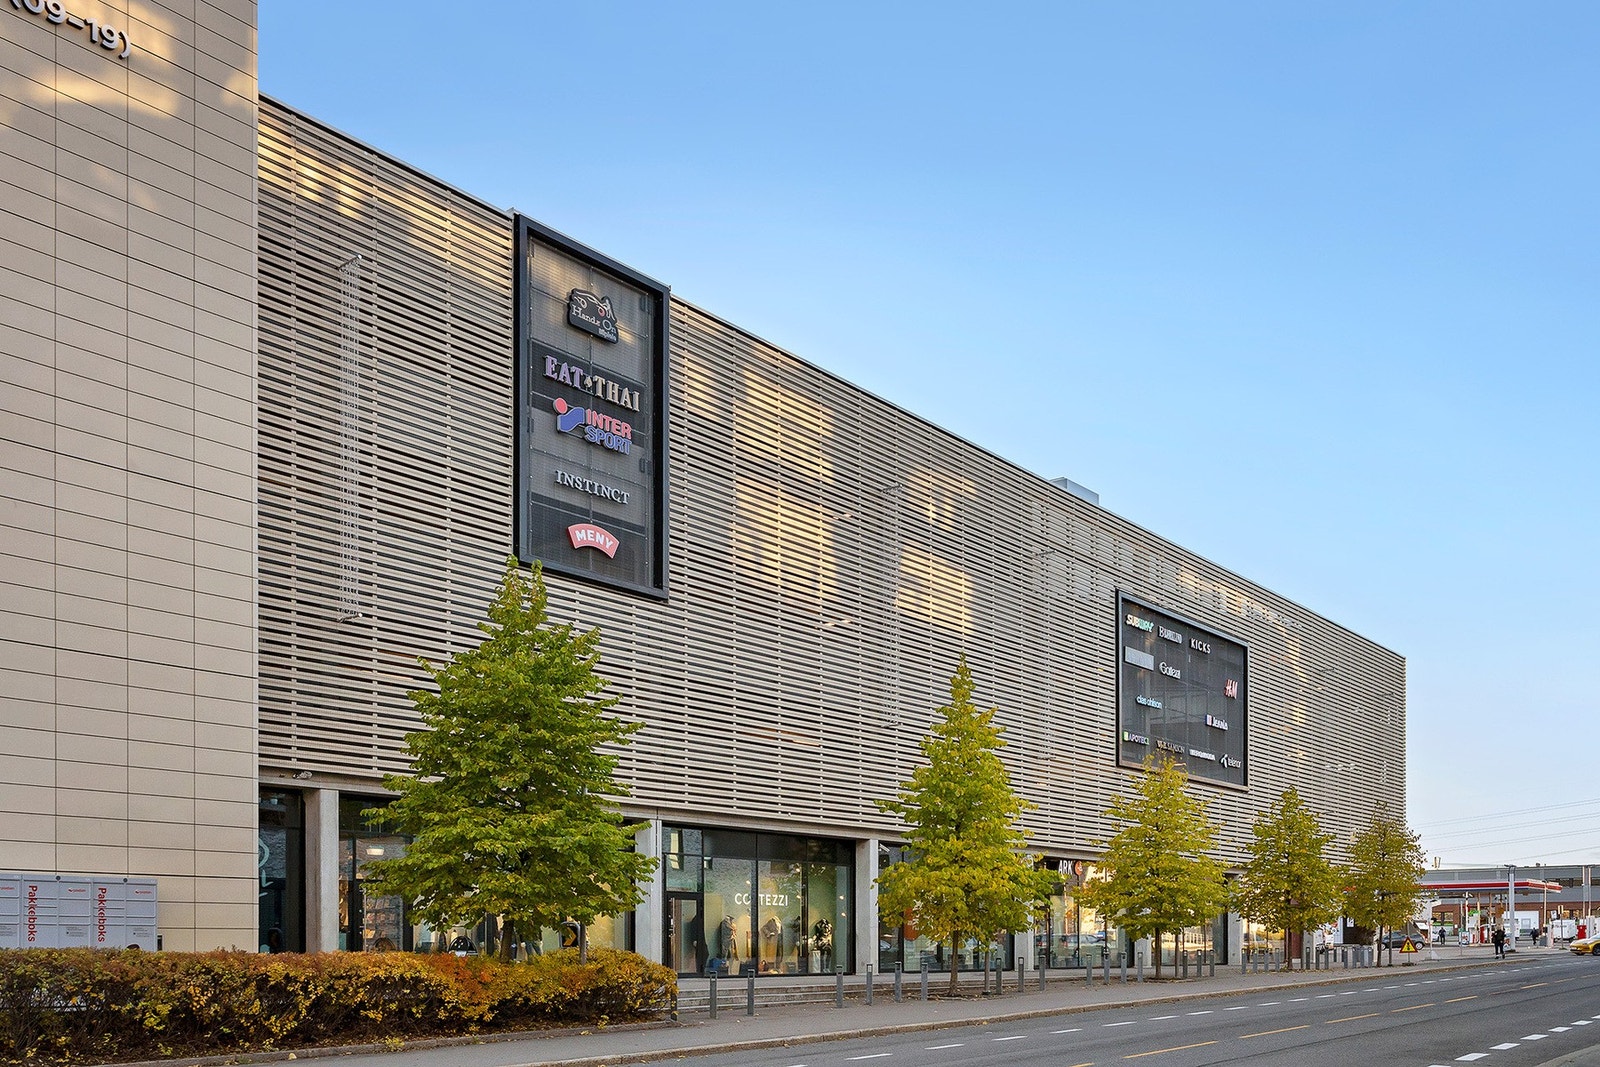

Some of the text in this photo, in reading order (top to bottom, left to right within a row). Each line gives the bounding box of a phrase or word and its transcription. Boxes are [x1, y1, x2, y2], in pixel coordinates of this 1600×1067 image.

[544, 355, 640, 412] EAT THAI
[586, 408, 632, 439] INTER
[584, 425, 632, 455] SPORT
[555, 470, 630, 504] INSTINCT
[575, 528, 614, 549] MENY
[1190, 637, 1211, 654] KICKS
[1058, 859, 1073, 875] ARK
[27, 885, 38, 942] Pakkeboks
[734, 892, 789, 907] COTEZZI
[97, 887, 107, 943] Pakkeboks
